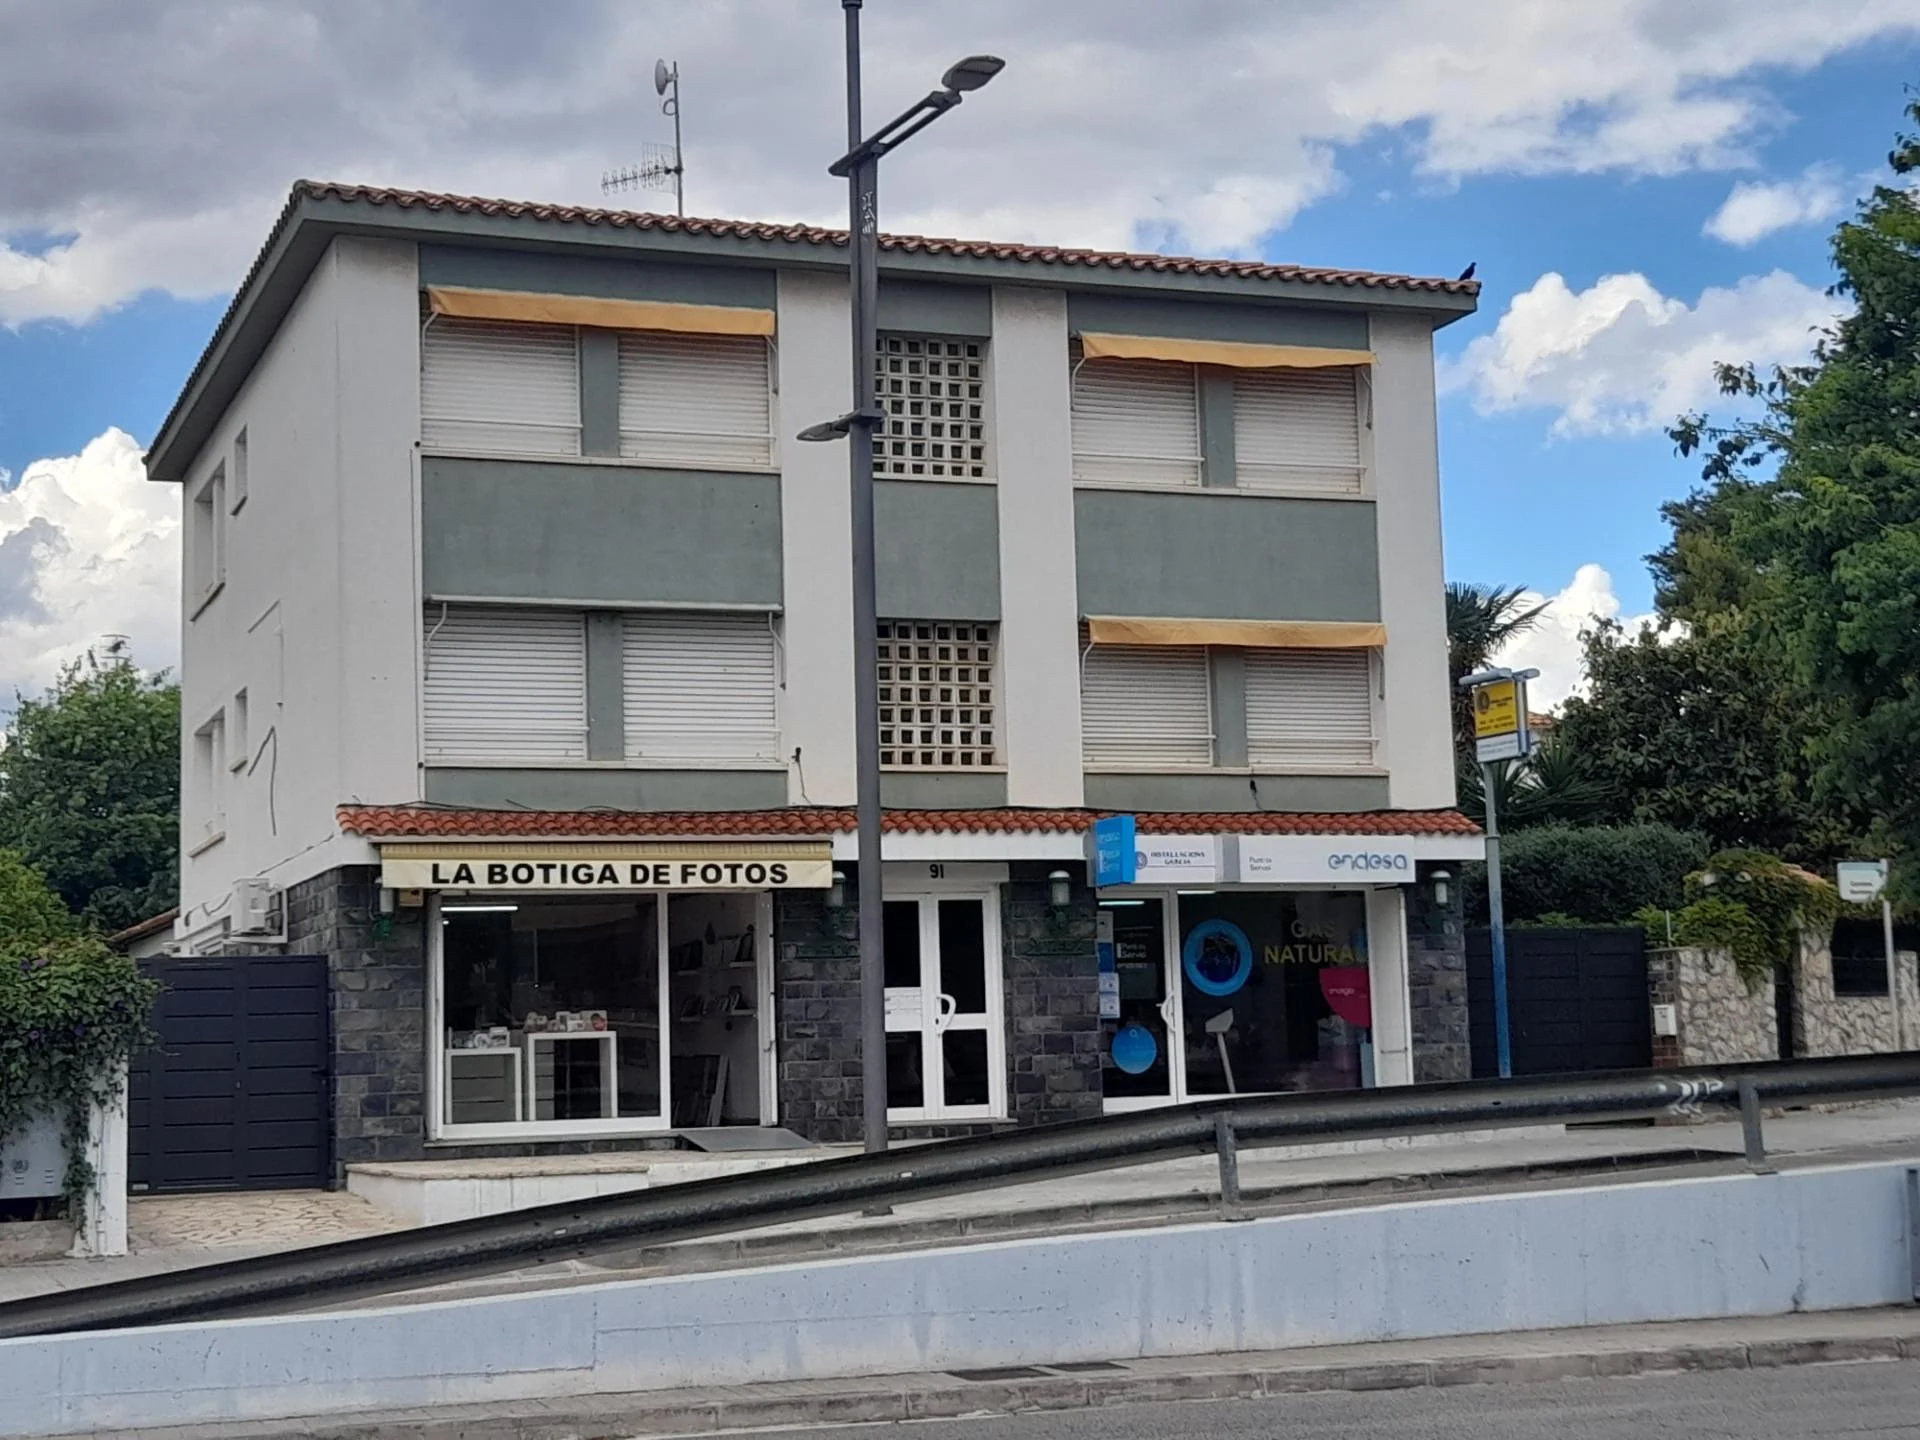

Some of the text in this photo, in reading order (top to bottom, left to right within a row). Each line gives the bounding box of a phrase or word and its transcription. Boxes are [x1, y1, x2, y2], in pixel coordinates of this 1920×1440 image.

[929, 863, 944, 879] 91
[1327, 852, 1408, 871] endesa
[431, 863, 789, 885] LA BOTIGA DE FOTOS
[1291, 919, 1336, 938] GAS
